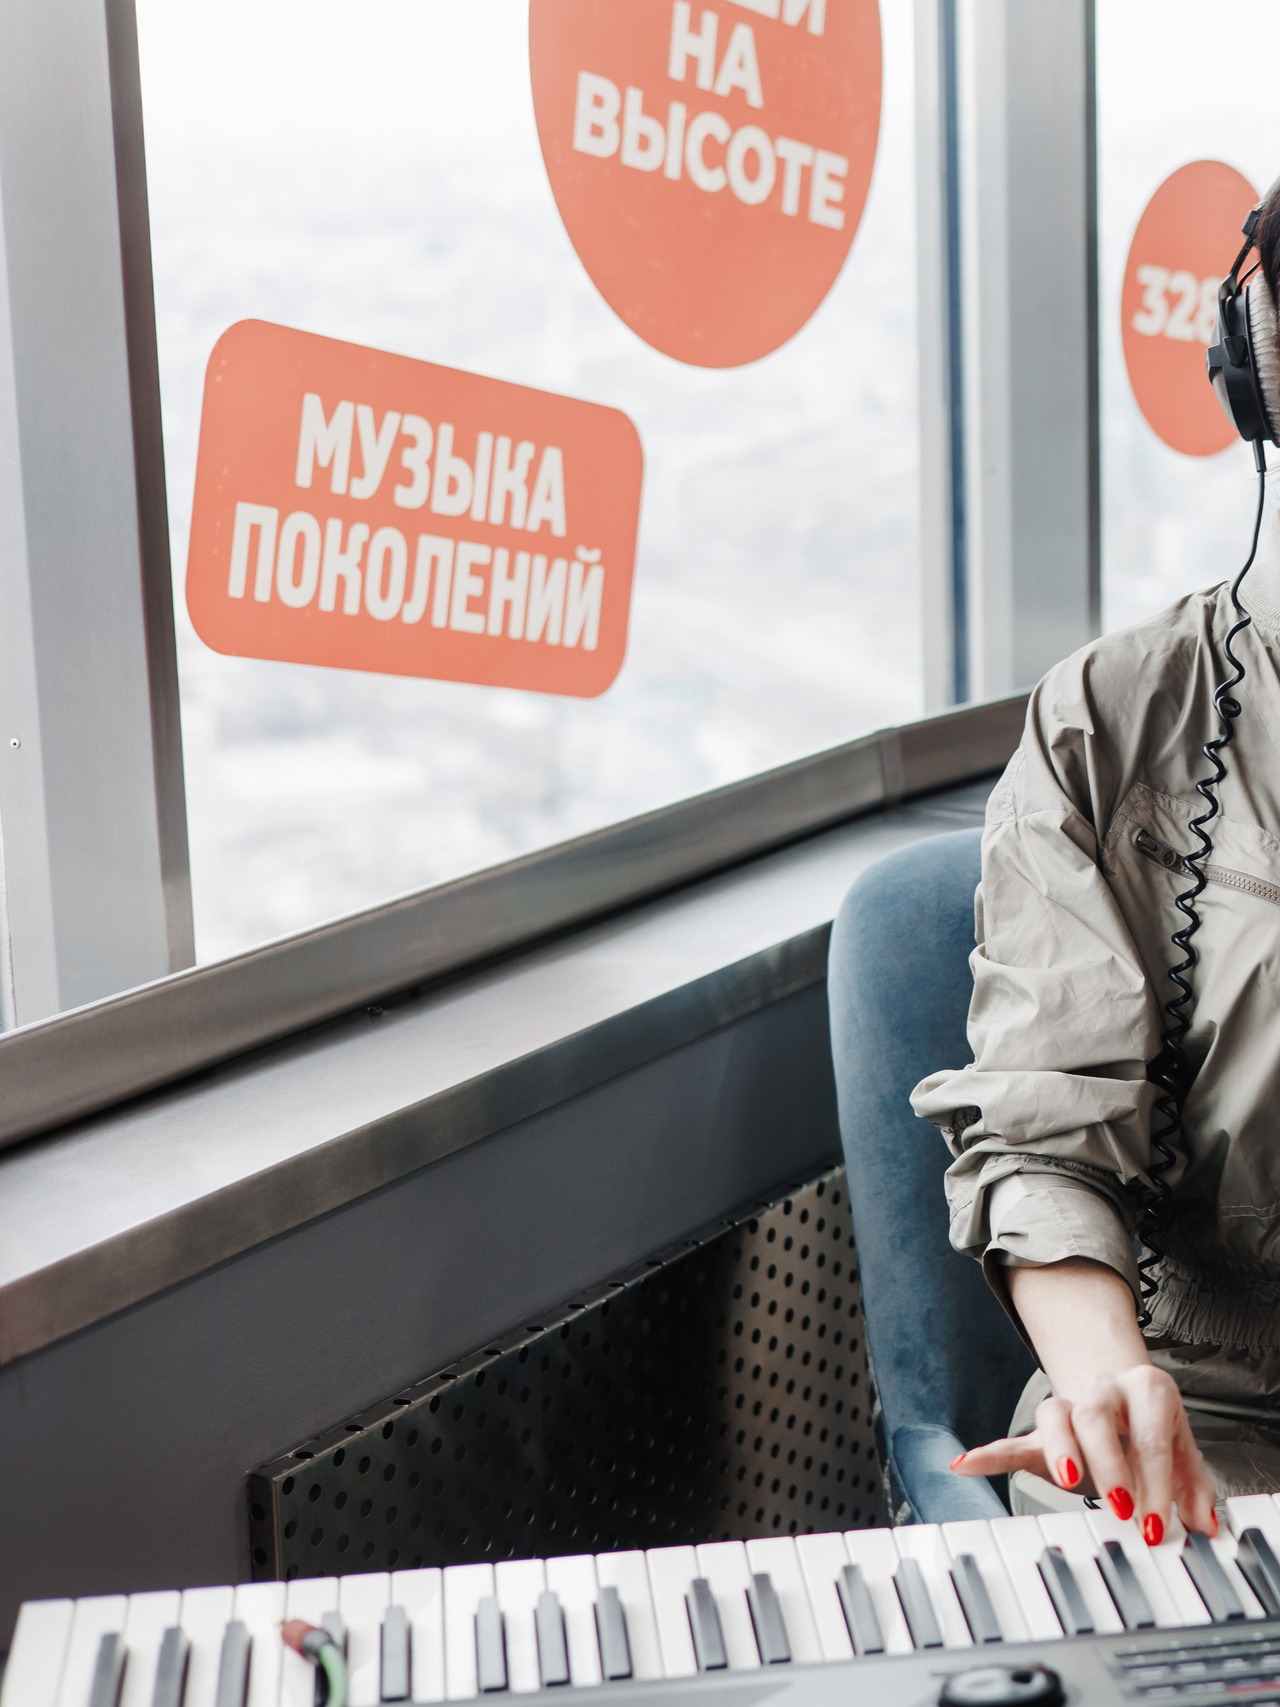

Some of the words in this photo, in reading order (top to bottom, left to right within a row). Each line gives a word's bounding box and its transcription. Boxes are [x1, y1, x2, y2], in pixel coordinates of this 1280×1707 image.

[667, 1, 765, 110] НА
[573, 70, 849, 231] ВЫСОТЕ
[295, 392, 567, 538] МУЗЫКА
[227, 501, 605, 651] ПОКОЛЕНИЙ
